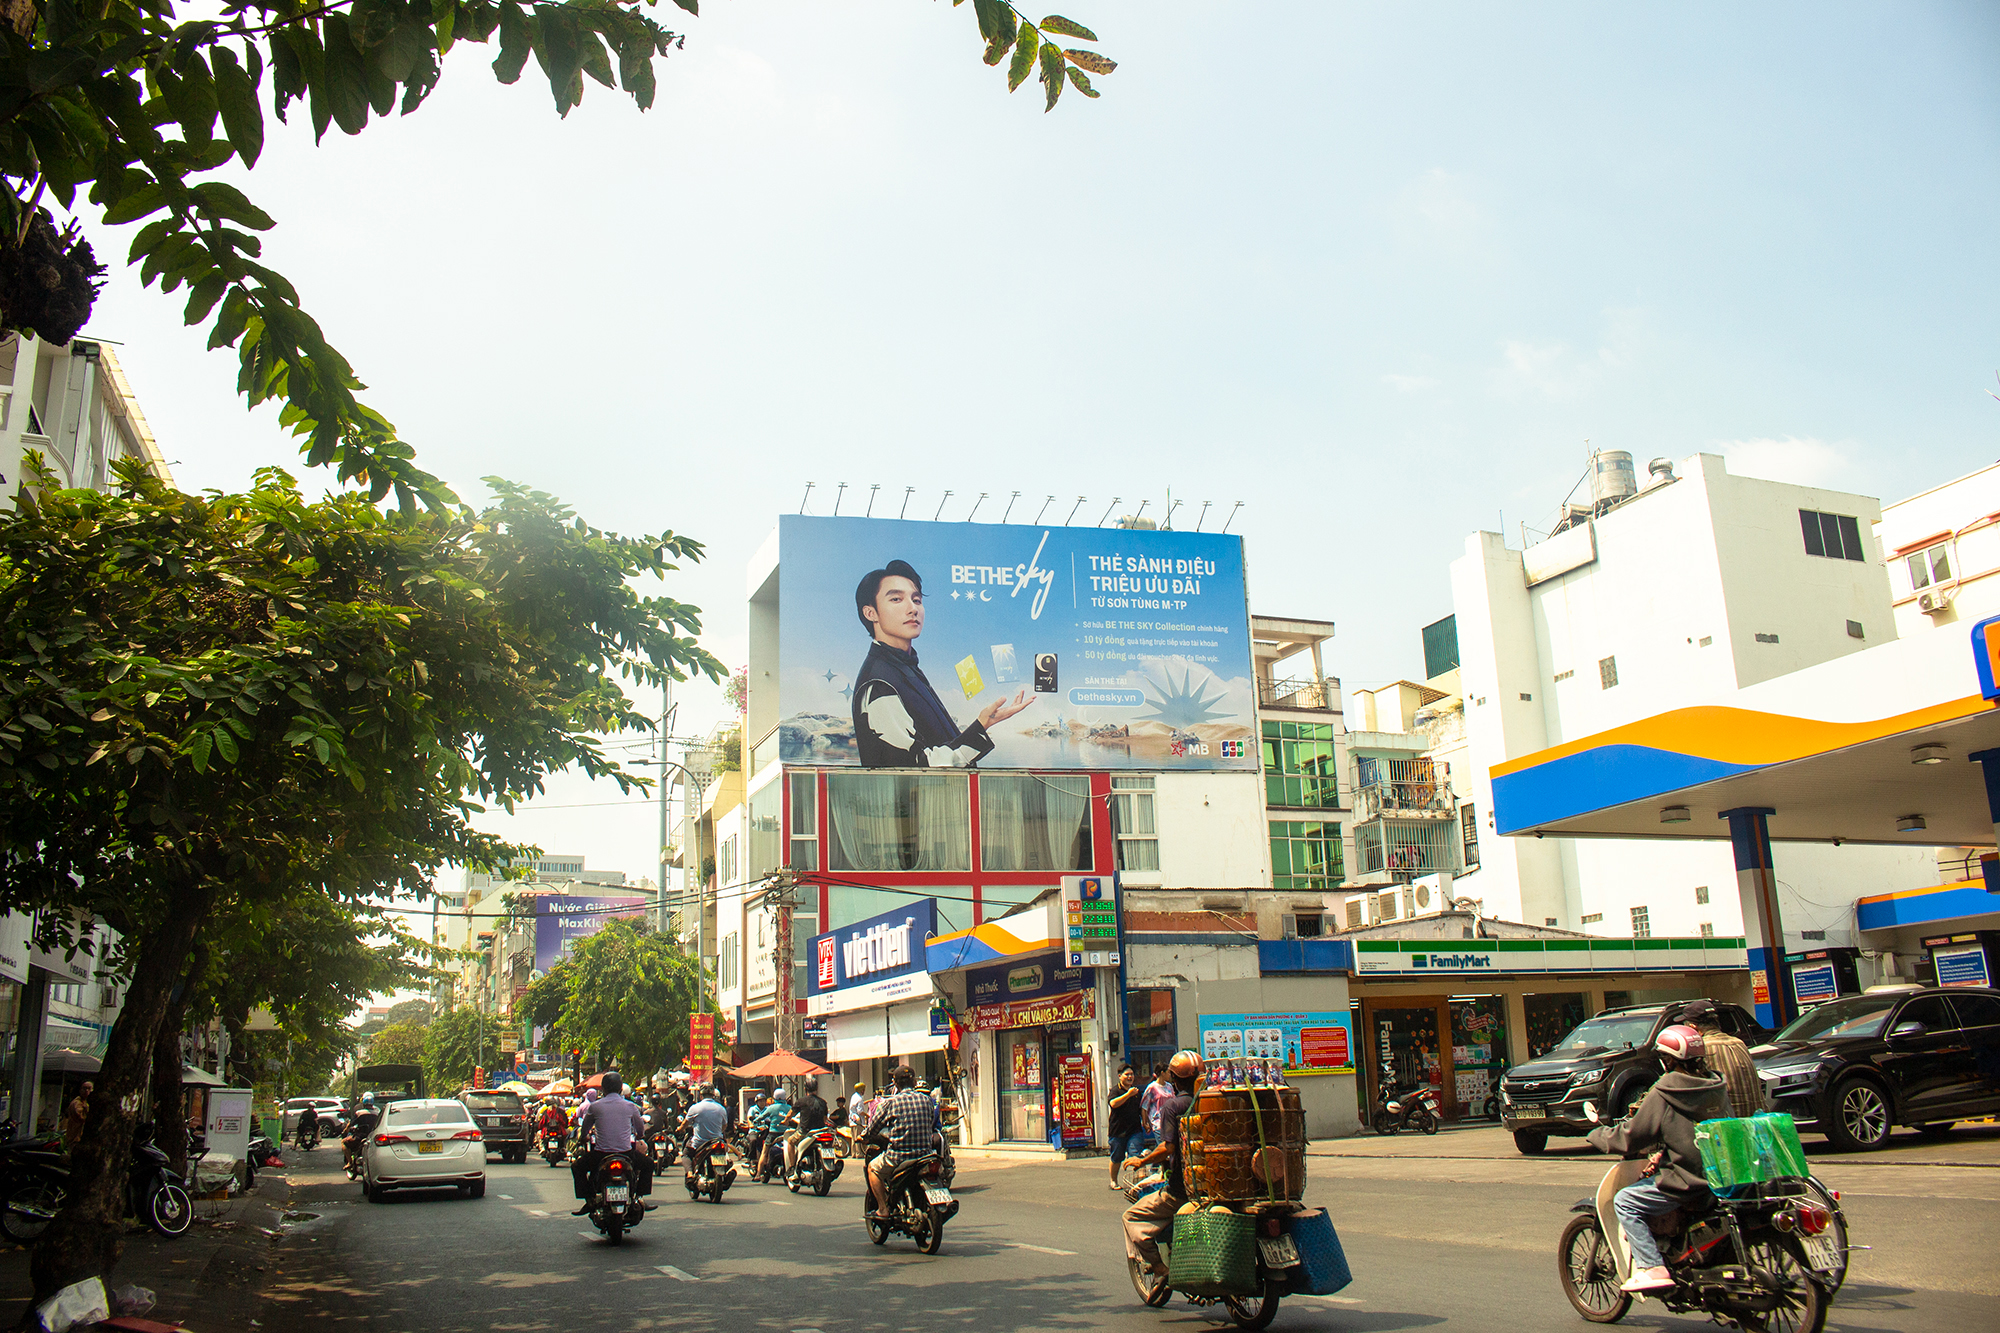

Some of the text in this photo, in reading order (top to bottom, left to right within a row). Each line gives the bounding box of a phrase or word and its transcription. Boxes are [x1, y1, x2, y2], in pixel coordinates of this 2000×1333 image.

[1089, 553, 1215, 578] THẺ SÀNH ĐIỆU
[1090, 574, 1200, 595] TRIỆU ƯU ĐÃI
[1091, 596, 1187, 610] TỪ SƠN TÙNG M-TP
[1106, 621, 1116, 629] BE
[1118, 621, 1135, 629] THE
[1137, 622, 1153, 630] SKY
[1155, 622, 1196, 631] Collection
[1084, 635, 1093, 643] 10
[1105, 634, 1125, 646] đồng
[1106, 649, 1126, 661] đồng
[1077, 692, 1136, 703] bethesky.vn
[1189, 744, 1209, 755] MB
[549, 902, 582, 913] Nước
[843, 923, 911, 978] viettien
[1430, 954, 1490, 968] FamilyMart
[1054, 968, 1082, 980] Pharmacy
[975, 979, 998, 994] Nhà Thuốc
[1018, 1007, 1030, 1024] CHỈ
[1032, 1007, 1052, 1023] VÀNG
[1063, 1005, 1074, 1018] XU
[1071, 1091, 1084, 1100] CHỈ
[1066, 1101, 1086, 1110] VÀNG
